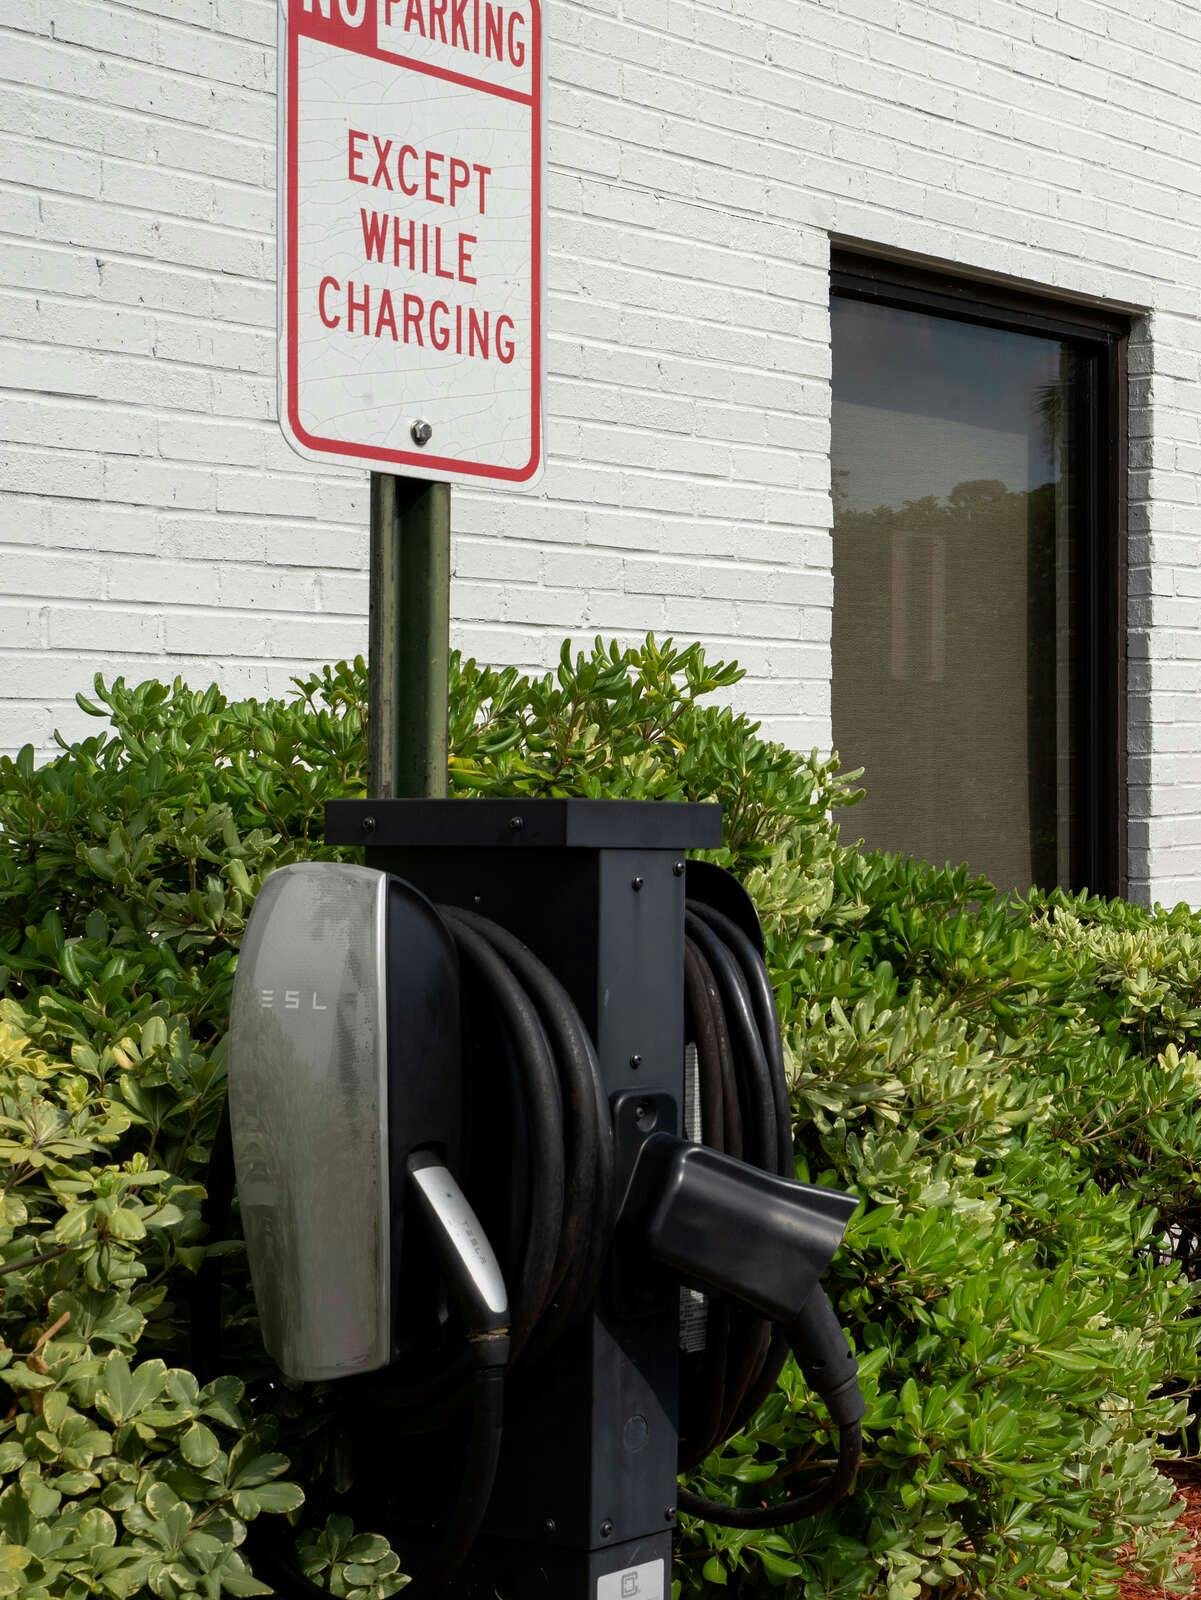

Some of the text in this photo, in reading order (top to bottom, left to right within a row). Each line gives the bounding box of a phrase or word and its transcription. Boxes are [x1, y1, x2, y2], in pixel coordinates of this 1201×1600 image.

[347, 128, 492, 214] EXCEPT
[360, 207, 478, 285] WHILE
[318, 275, 516, 365] CHARGING
